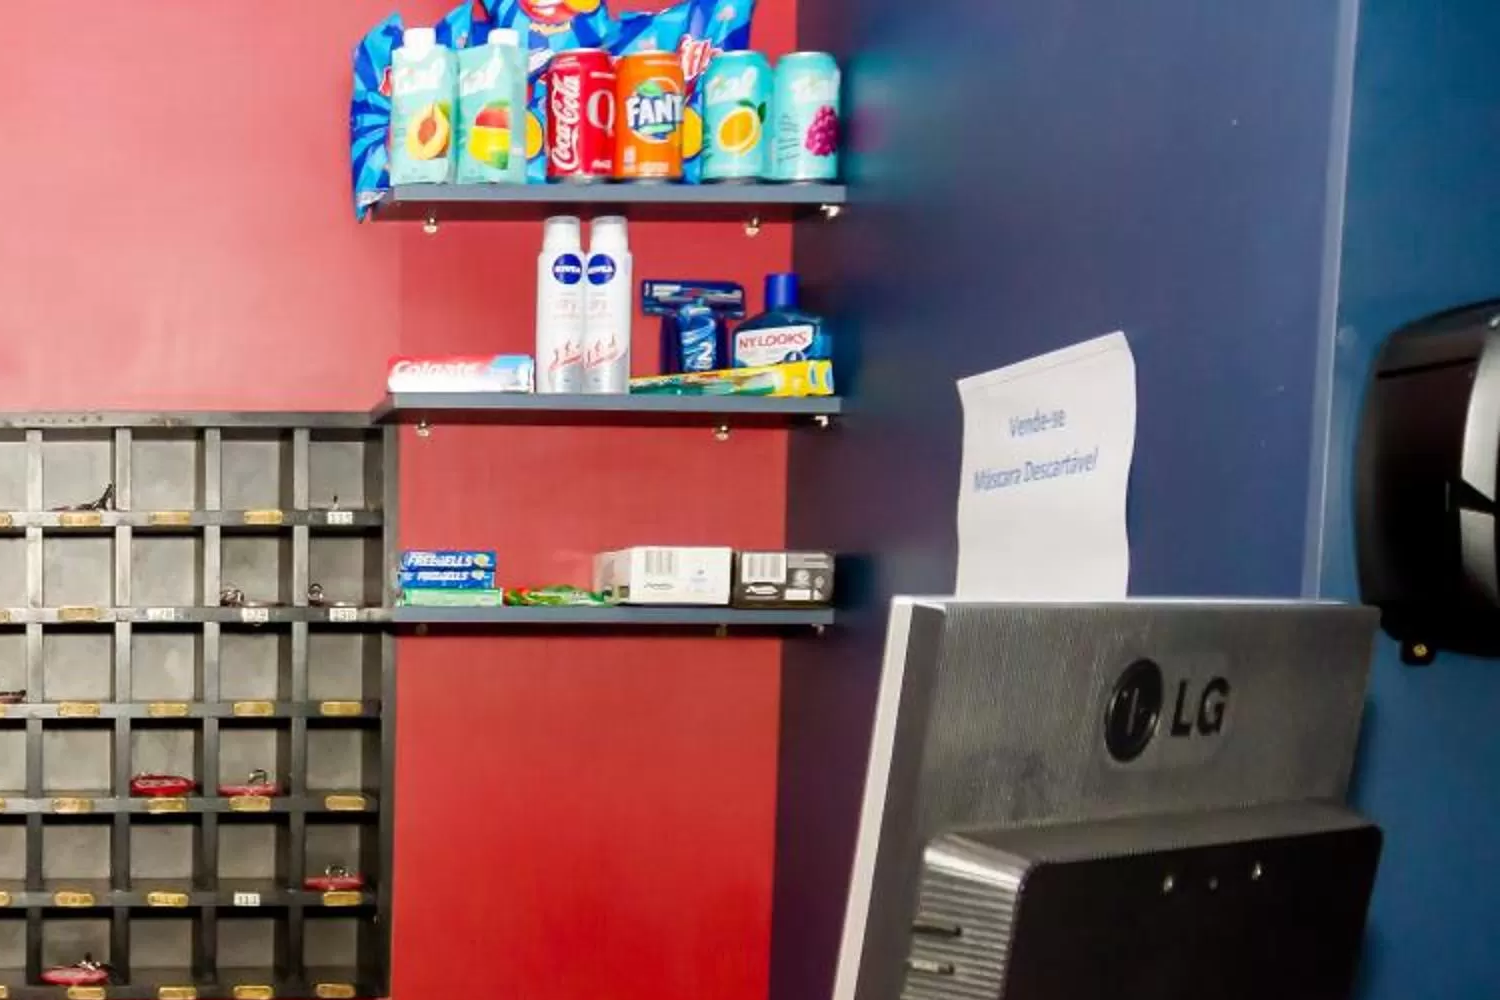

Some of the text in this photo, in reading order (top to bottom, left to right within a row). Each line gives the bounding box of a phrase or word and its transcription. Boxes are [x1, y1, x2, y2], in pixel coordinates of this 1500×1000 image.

[626, 93, 683, 127] FANT
[1008, 407, 1066, 438] Vende-se
[1169, 676, 1231, 737] LG
